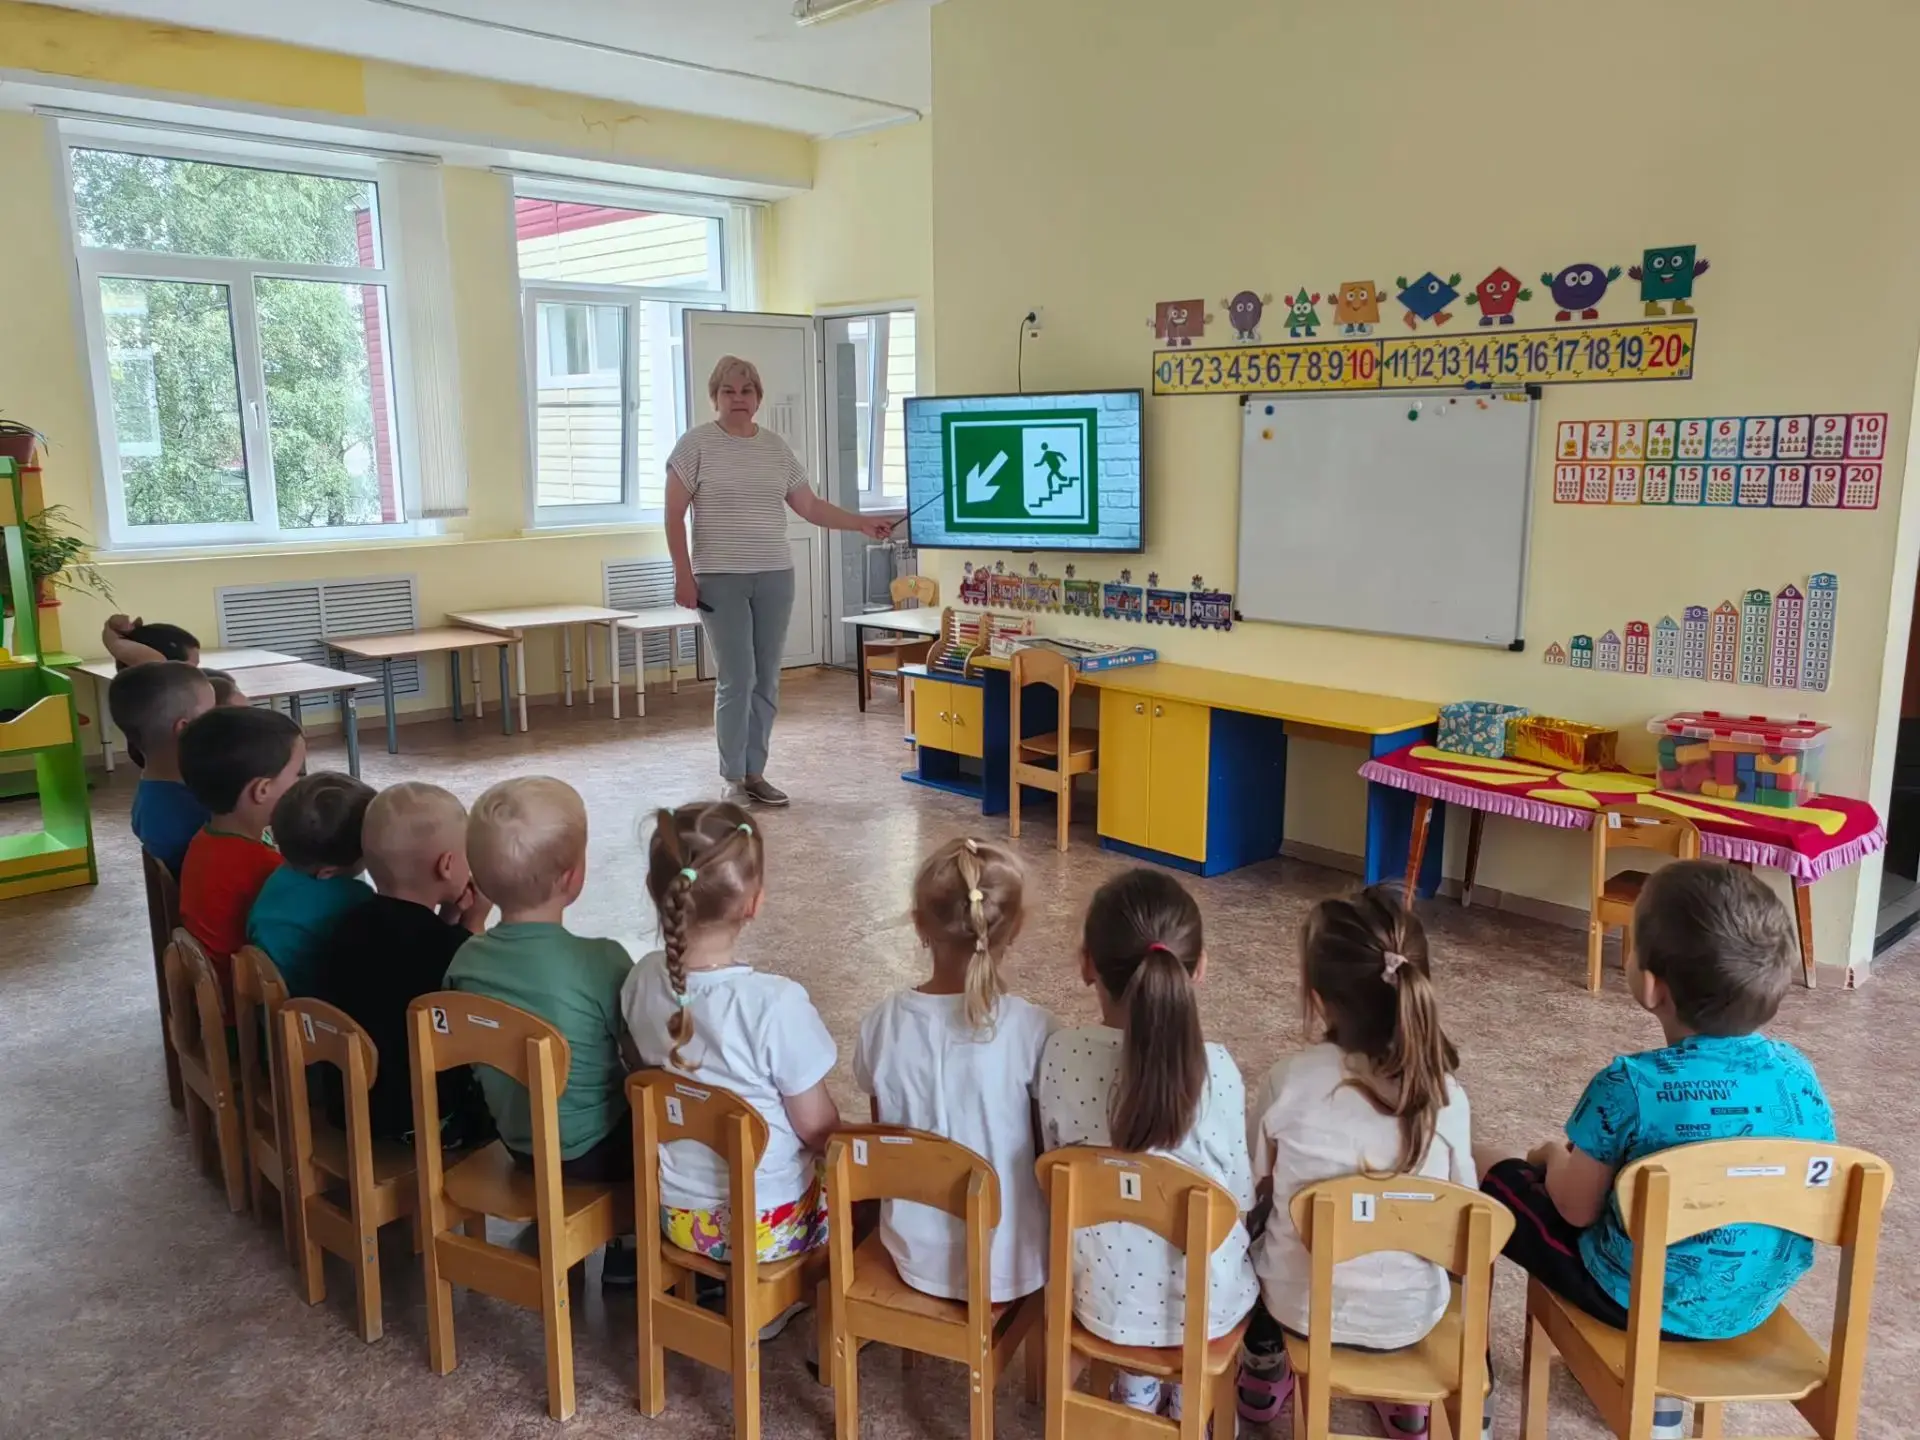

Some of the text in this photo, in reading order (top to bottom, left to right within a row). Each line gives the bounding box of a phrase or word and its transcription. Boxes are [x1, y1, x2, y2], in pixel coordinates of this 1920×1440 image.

[1161, 334, 1682, 385] 0 1 2 3 4 5 6 7 8 9 10 11 12 13 14 15 16 17 18 19 20
[1568, 418, 1878, 437] 1 2 3 4 5 6 7 8 9 10
[1561, 468, 1873, 482] 11 12 13 14 15 16 17 18 19 20
[435, 1011, 446, 1029] 2
[304, 1020, 310, 1038] 1
[1663, 1080, 1739, 1090] BARYONYX
[1656, 1089, 1731, 1103] RUNNN!
[669, 1104, 677, 1117] 1
[857, 1146, 862, 1159] 1
[1809, 1160, 1828, 1184] 2
[1124, 1179, 1133, 1196] 1
[1360, 1200, 1369, 1217] 1
